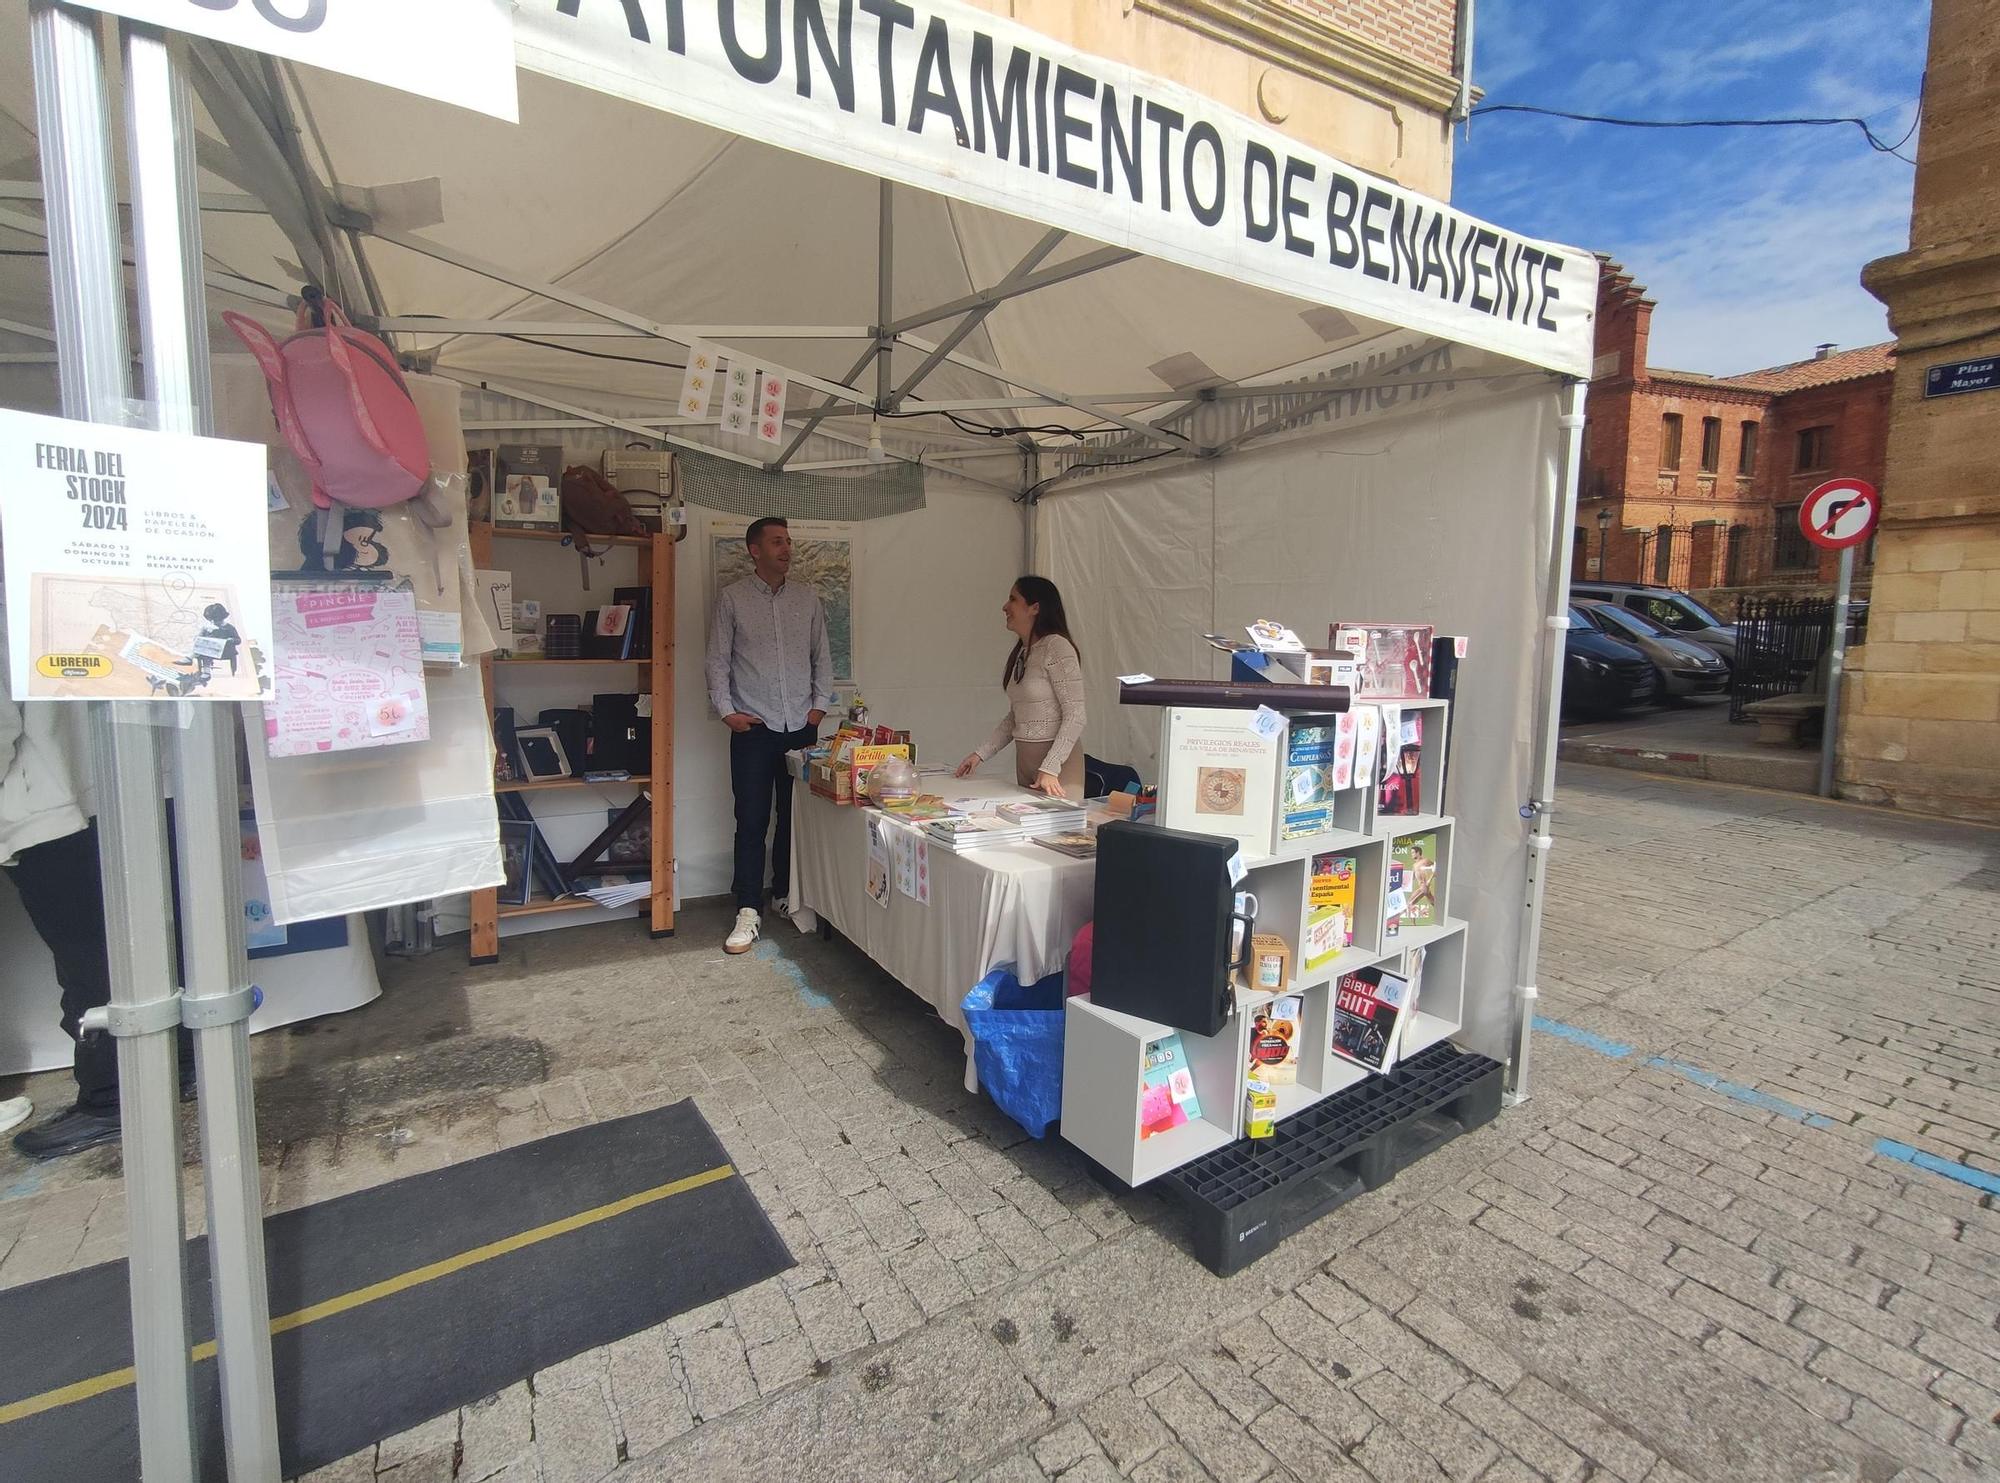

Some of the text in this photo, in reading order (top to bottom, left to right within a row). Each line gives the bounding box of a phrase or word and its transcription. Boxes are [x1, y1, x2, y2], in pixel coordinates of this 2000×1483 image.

[1244, 139, 1318, 257] DE
[1327, 172, 1564, 332] BENAVENTE
[1958, 364, 1994, 375] Plaza
[1950, 377, 1991, 388] Mayor
[35, 442, 125, 478] FERIA DEL
[66, 475, 126, 505] STOCK
[81, 504, 128, 531] 2024
[144, 511, 186, 519] LIBROS
[64, 549, 116, 558] DOMINGO
[146, 554, 177, 562] PLAZA
[81, 558, 131, 567] OCTUBRE
[147, 562, 203, 571] BENAVENTE
[50, 656, 100, 667] LIBRERIA
[1186, 738, 1260, 748] PRIVILEGIOS REALES
[1312, 883, 1350, 891] sentimental
[1311, 891, 1334, 899] España
[1337, 990, 1374, 1016] HIIT
